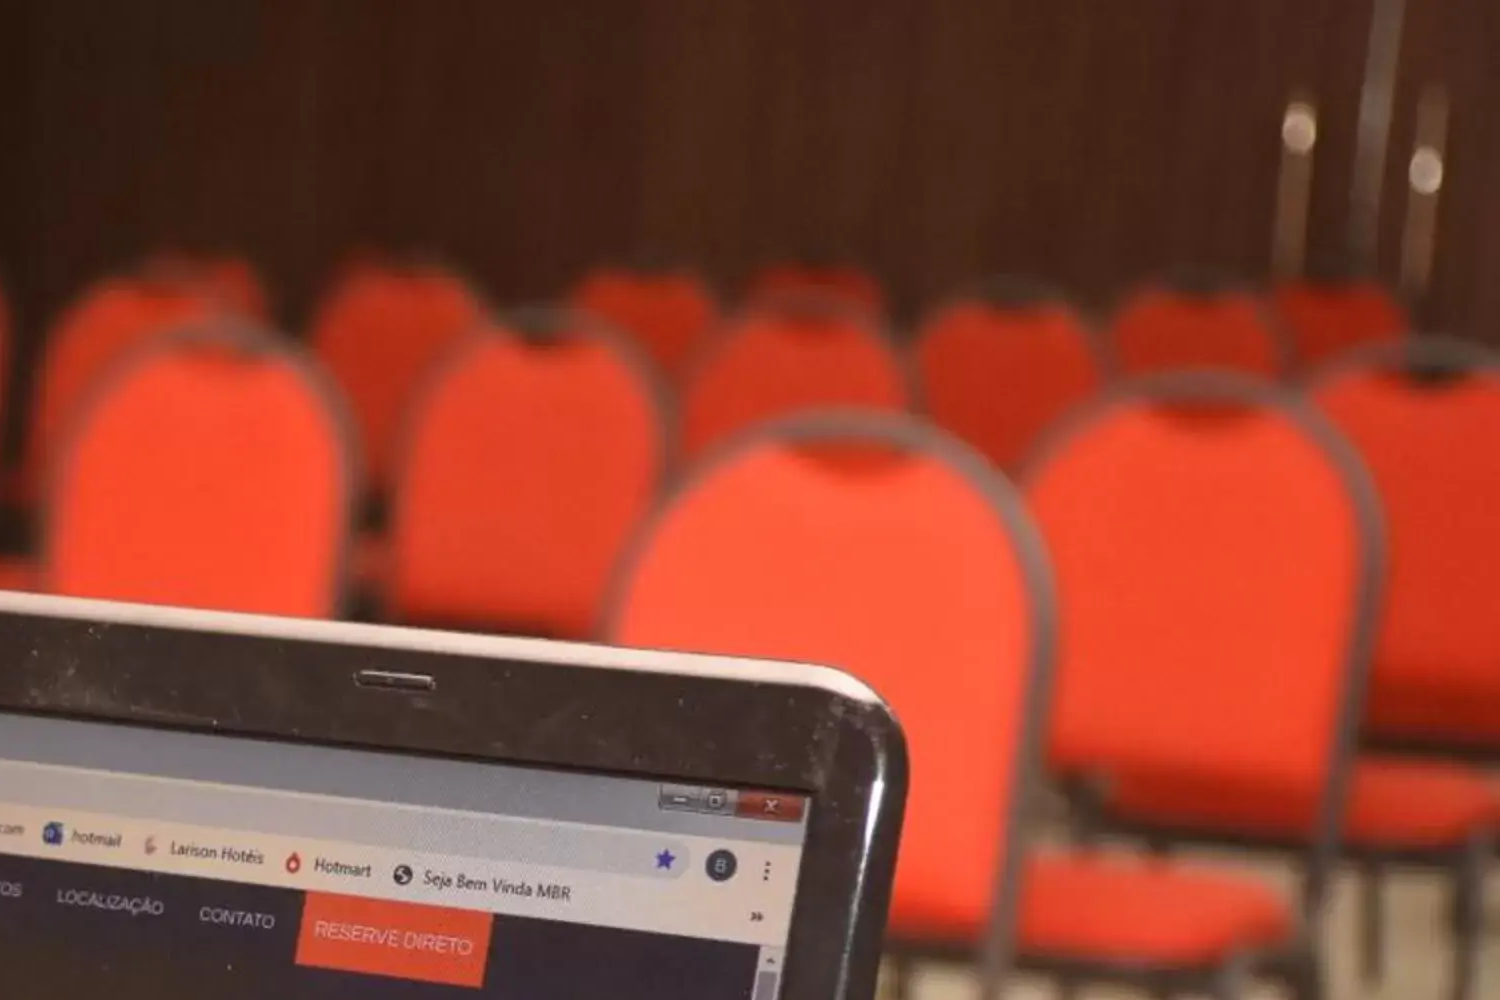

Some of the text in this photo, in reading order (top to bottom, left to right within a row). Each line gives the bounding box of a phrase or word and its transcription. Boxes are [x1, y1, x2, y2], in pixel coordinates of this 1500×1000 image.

[71, 829, 122, 849] hotmail
[171, 840, 218, 860] Larison
[314, 858, 372, 878] Hotmart
[423, 870, 572, 901] Seja Bem Vinda MBR
[56, 888, 165, 917] LOCALIZAÇÃO
[199, 905, 276, 930] CONTATO
[314, 919, 474, 957] RESERVE DIRETO
